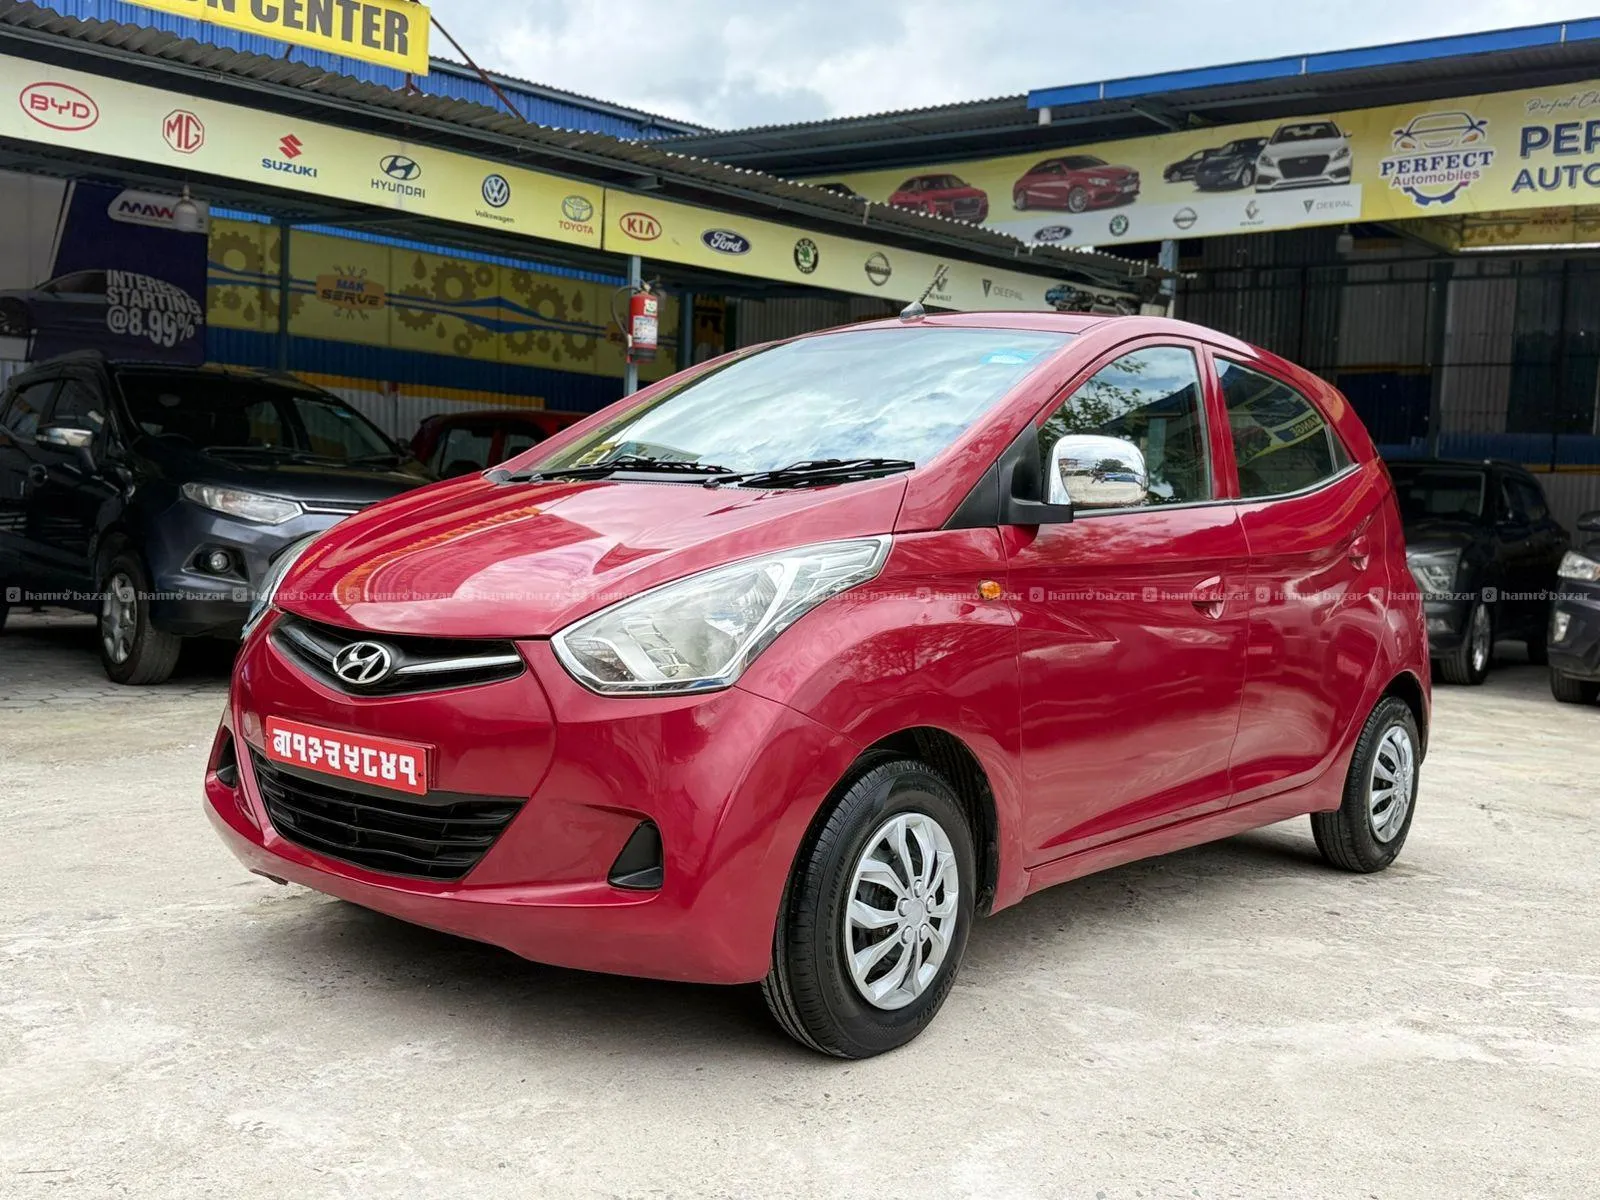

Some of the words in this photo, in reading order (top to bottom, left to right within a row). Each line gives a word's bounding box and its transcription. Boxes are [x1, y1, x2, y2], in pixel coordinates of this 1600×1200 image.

[29, 92, 92, 120] BYD
[165, 113, 203, 150] MG
[261, 157, 318, 179] SUZUKI
[1380, 150, 1495, 178] PERFECT
[371, 178, 426, 199] HYUNDAI
[1391, 169, 1480, 188] Automobiles
[474, 208, 516, 225] Volkswagen
[558, 219, 595, 235] TOYOTA
[627, 217, 655, 237] KIA
[710, 230, 743, 252] Ford
[107, 286, 203, 315] STARTING
[322, 288, 382, 306] SERVE
